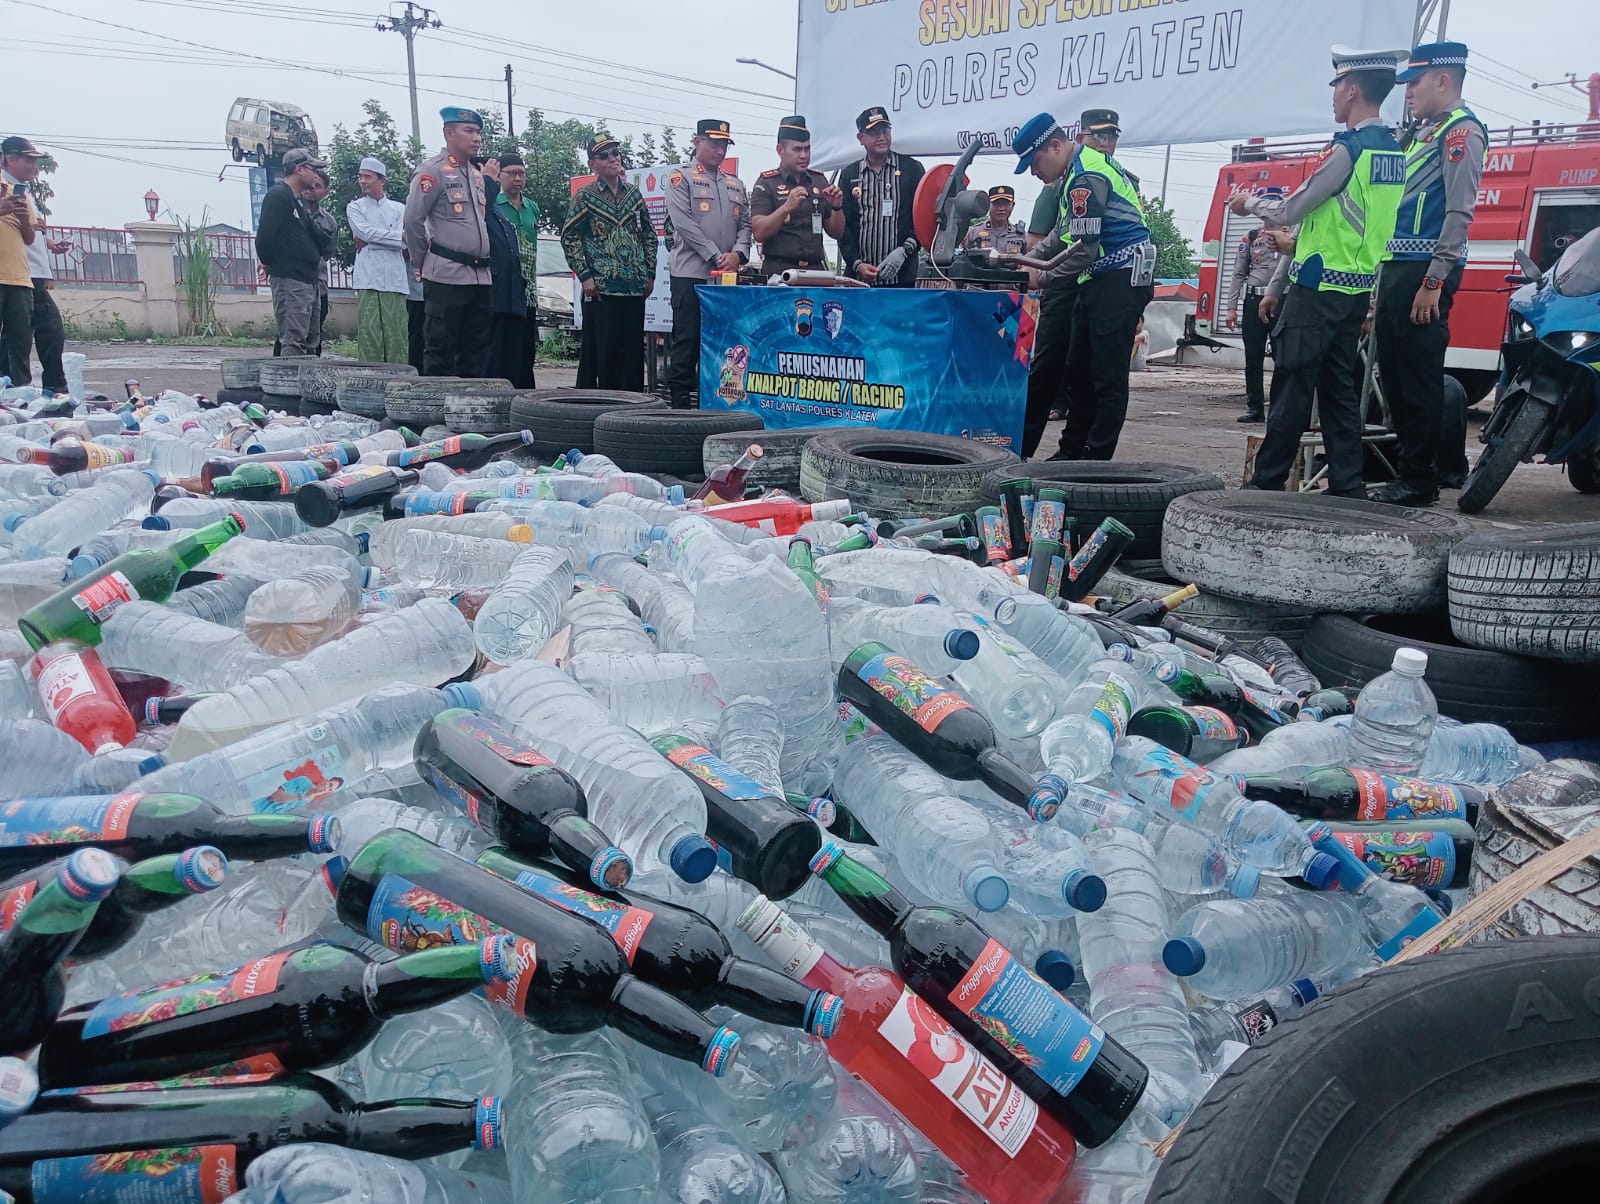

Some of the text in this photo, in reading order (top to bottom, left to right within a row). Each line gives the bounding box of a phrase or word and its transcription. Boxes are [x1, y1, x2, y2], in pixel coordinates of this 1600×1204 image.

[919, 0, 1010, 46] SESUAI
[892, 9, 1243, 112] POLRES KLATEN
[1559, 168, 1598, 184] PUMP
[778, 352, 865, 381] PEMUSNAHAN
[747, 373, 905, 409] KNALPOT BRONG / RACING
[760, 399, 878, 422] SAT LANTAS POLRES KLATEN
[920, 696, 954, 724] Kolesom
[958, 947, 1005, 1001] Anggur Kolesom
